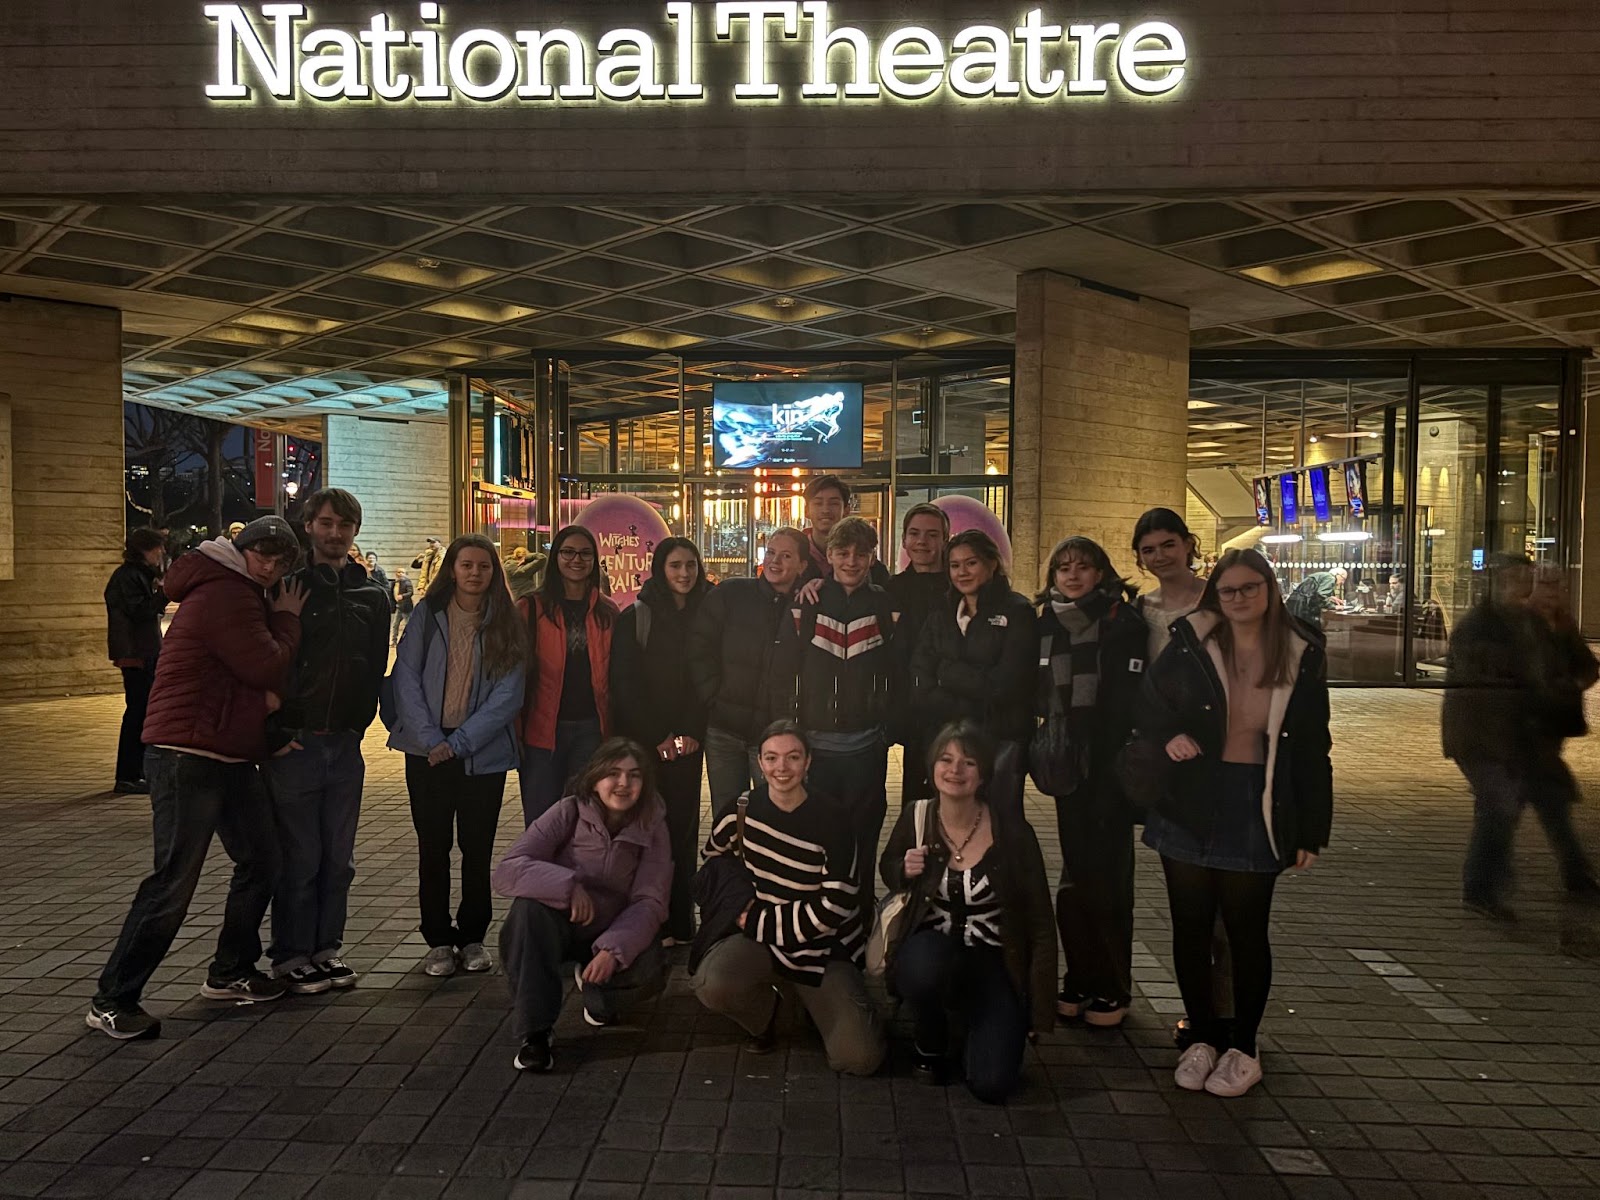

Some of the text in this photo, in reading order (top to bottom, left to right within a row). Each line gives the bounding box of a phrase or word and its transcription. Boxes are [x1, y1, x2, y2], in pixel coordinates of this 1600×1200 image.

[204, 1, 1187, 99] National Theatre
[257, 431, 271, 452] No
[599, 552, 654, 572] ENTUR
[608, 571, 642, 594] RAIL
